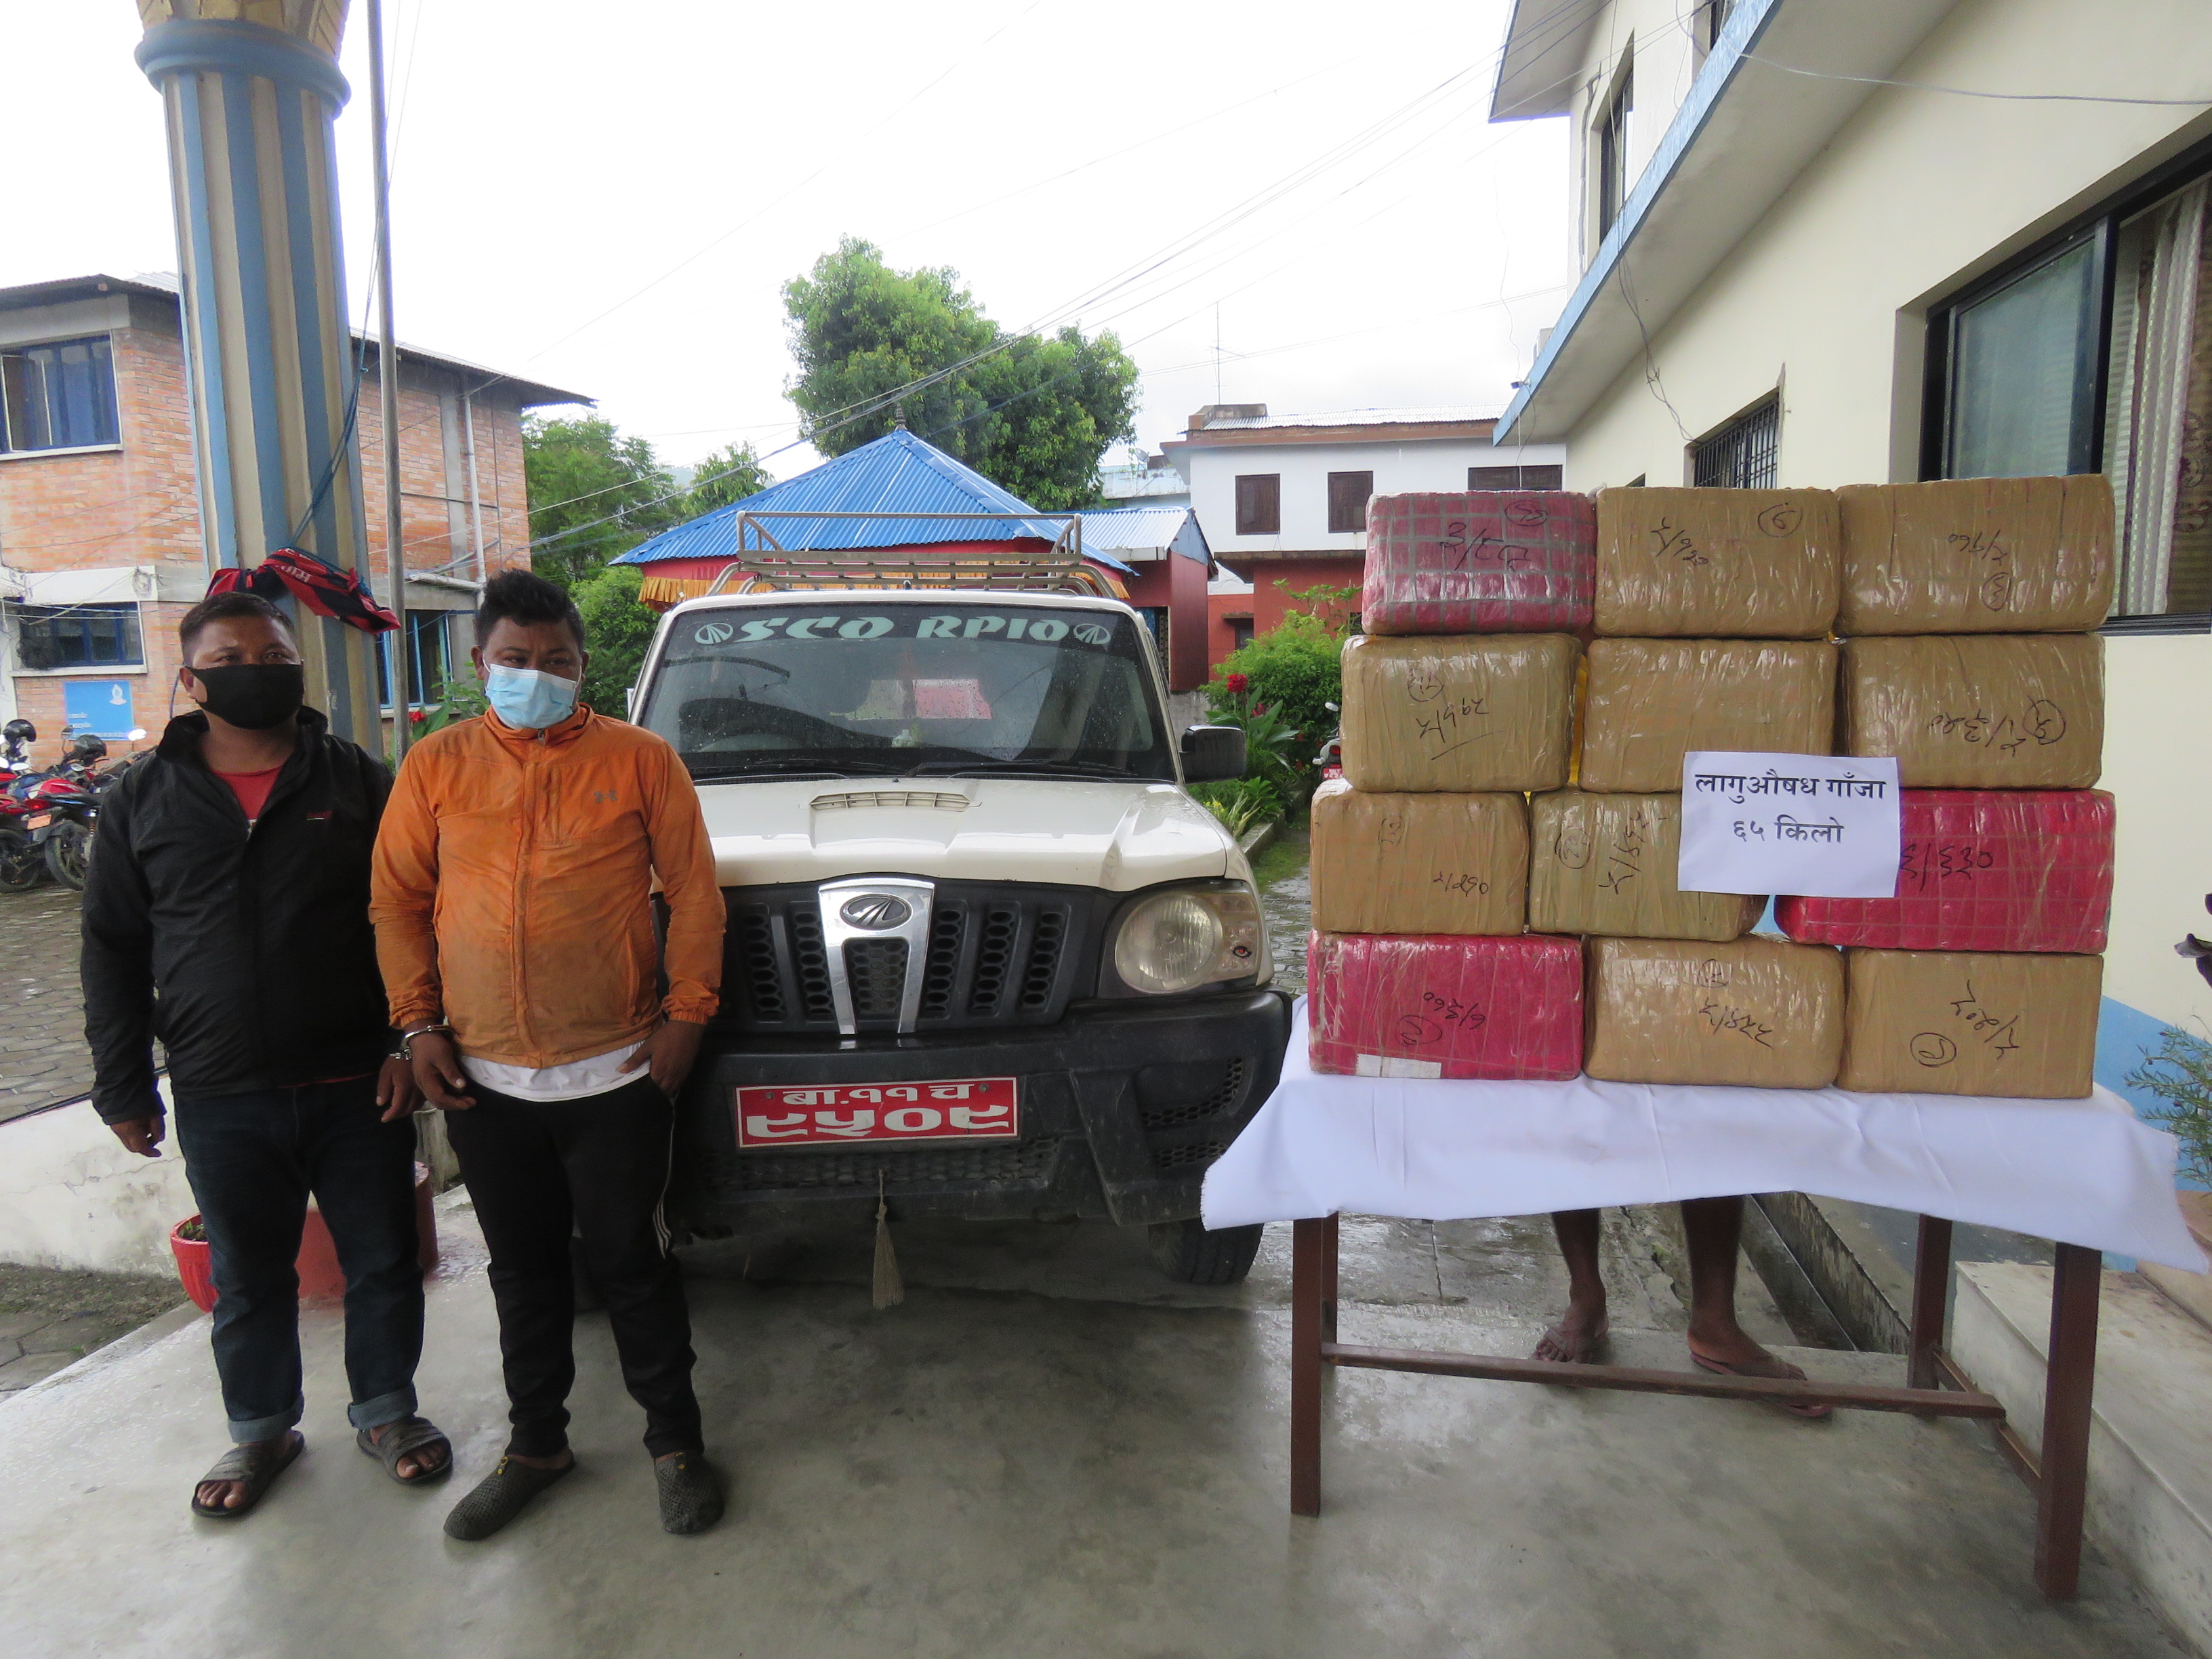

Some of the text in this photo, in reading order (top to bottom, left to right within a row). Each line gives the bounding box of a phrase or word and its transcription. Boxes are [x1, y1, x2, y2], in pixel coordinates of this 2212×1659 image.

[735, 615, 1073, 642] SCO RPIO
[1694, 768, 1887, 804] लागुऔषध गाँजा
[1732, 813, 1845, 844] ६५ किलो
[928, 1084, 975, 1100] च
